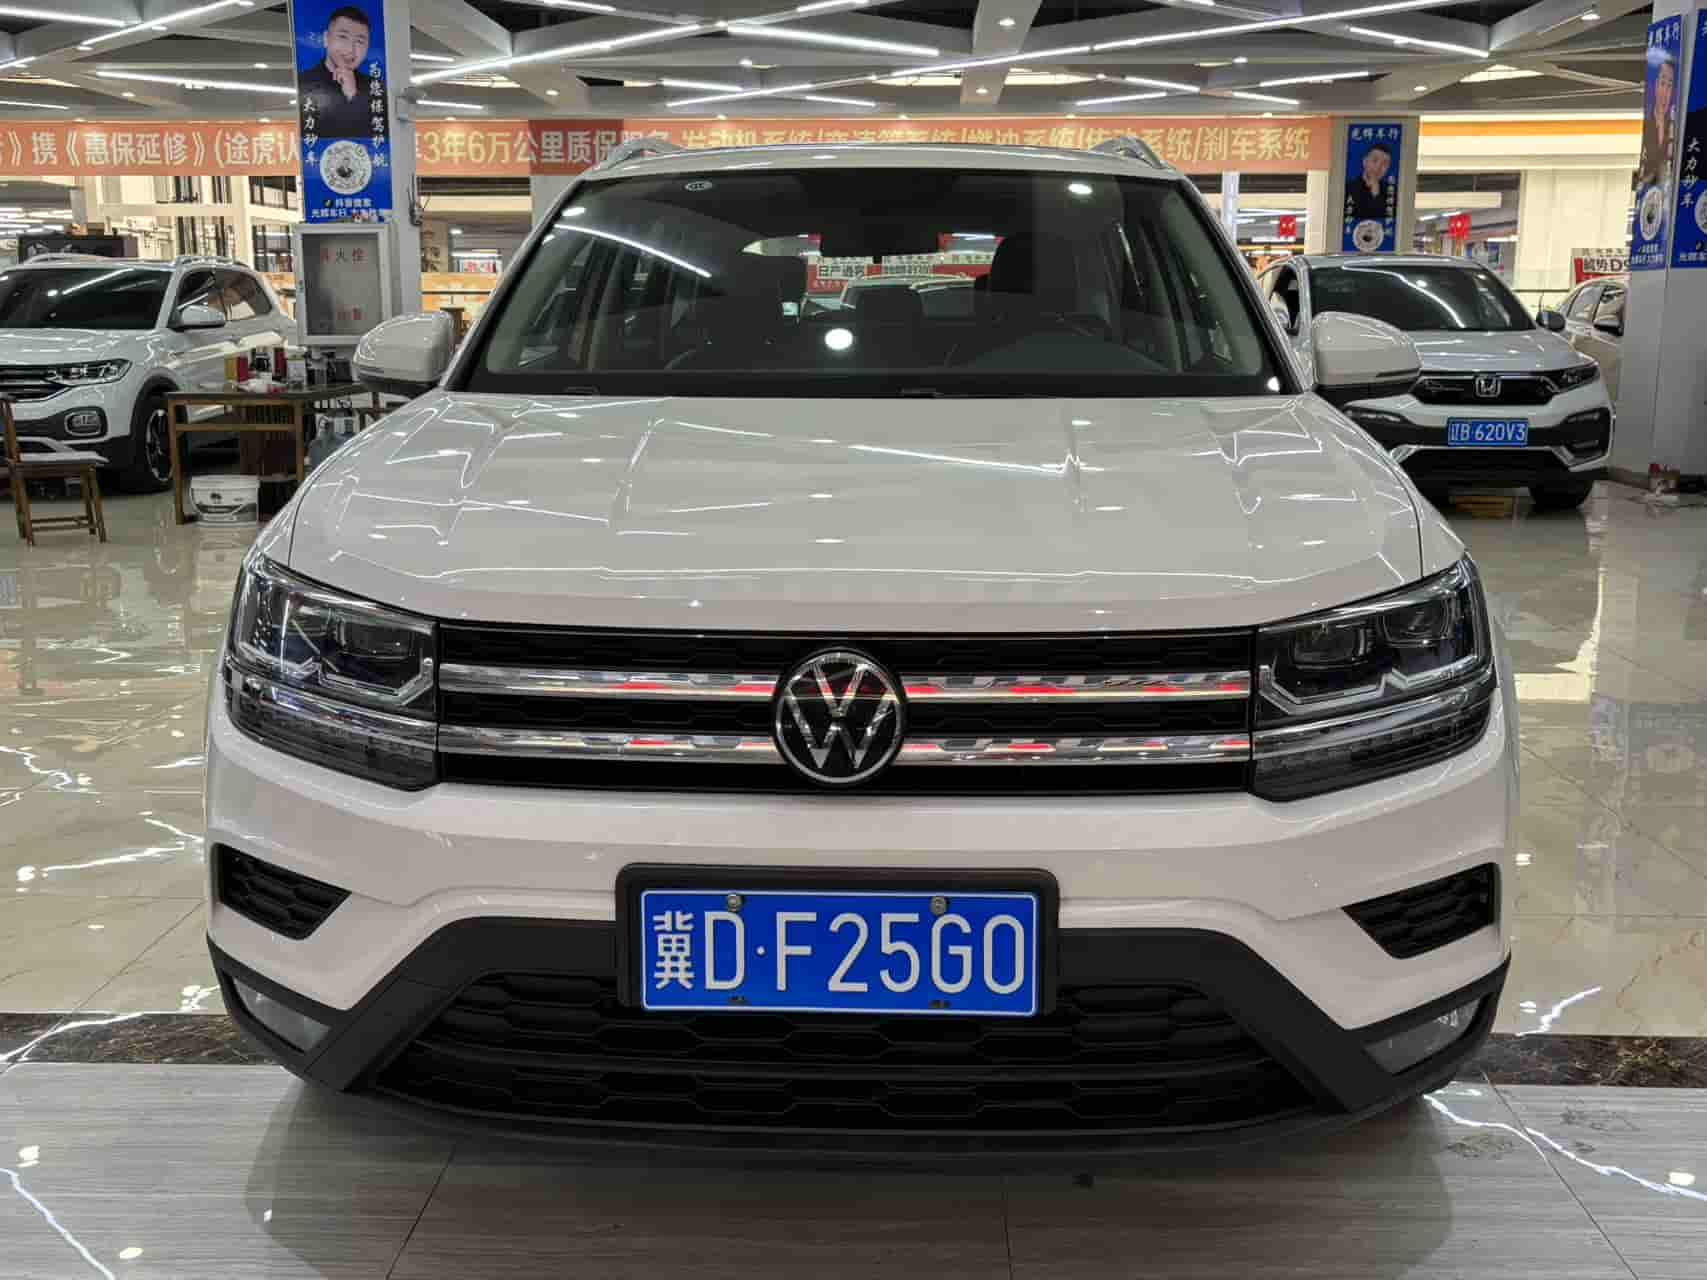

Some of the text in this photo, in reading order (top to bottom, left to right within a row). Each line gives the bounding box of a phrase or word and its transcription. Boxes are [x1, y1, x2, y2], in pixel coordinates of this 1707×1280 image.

[0, 130, 299, 167] 》携《惠保延修》(途虎认
